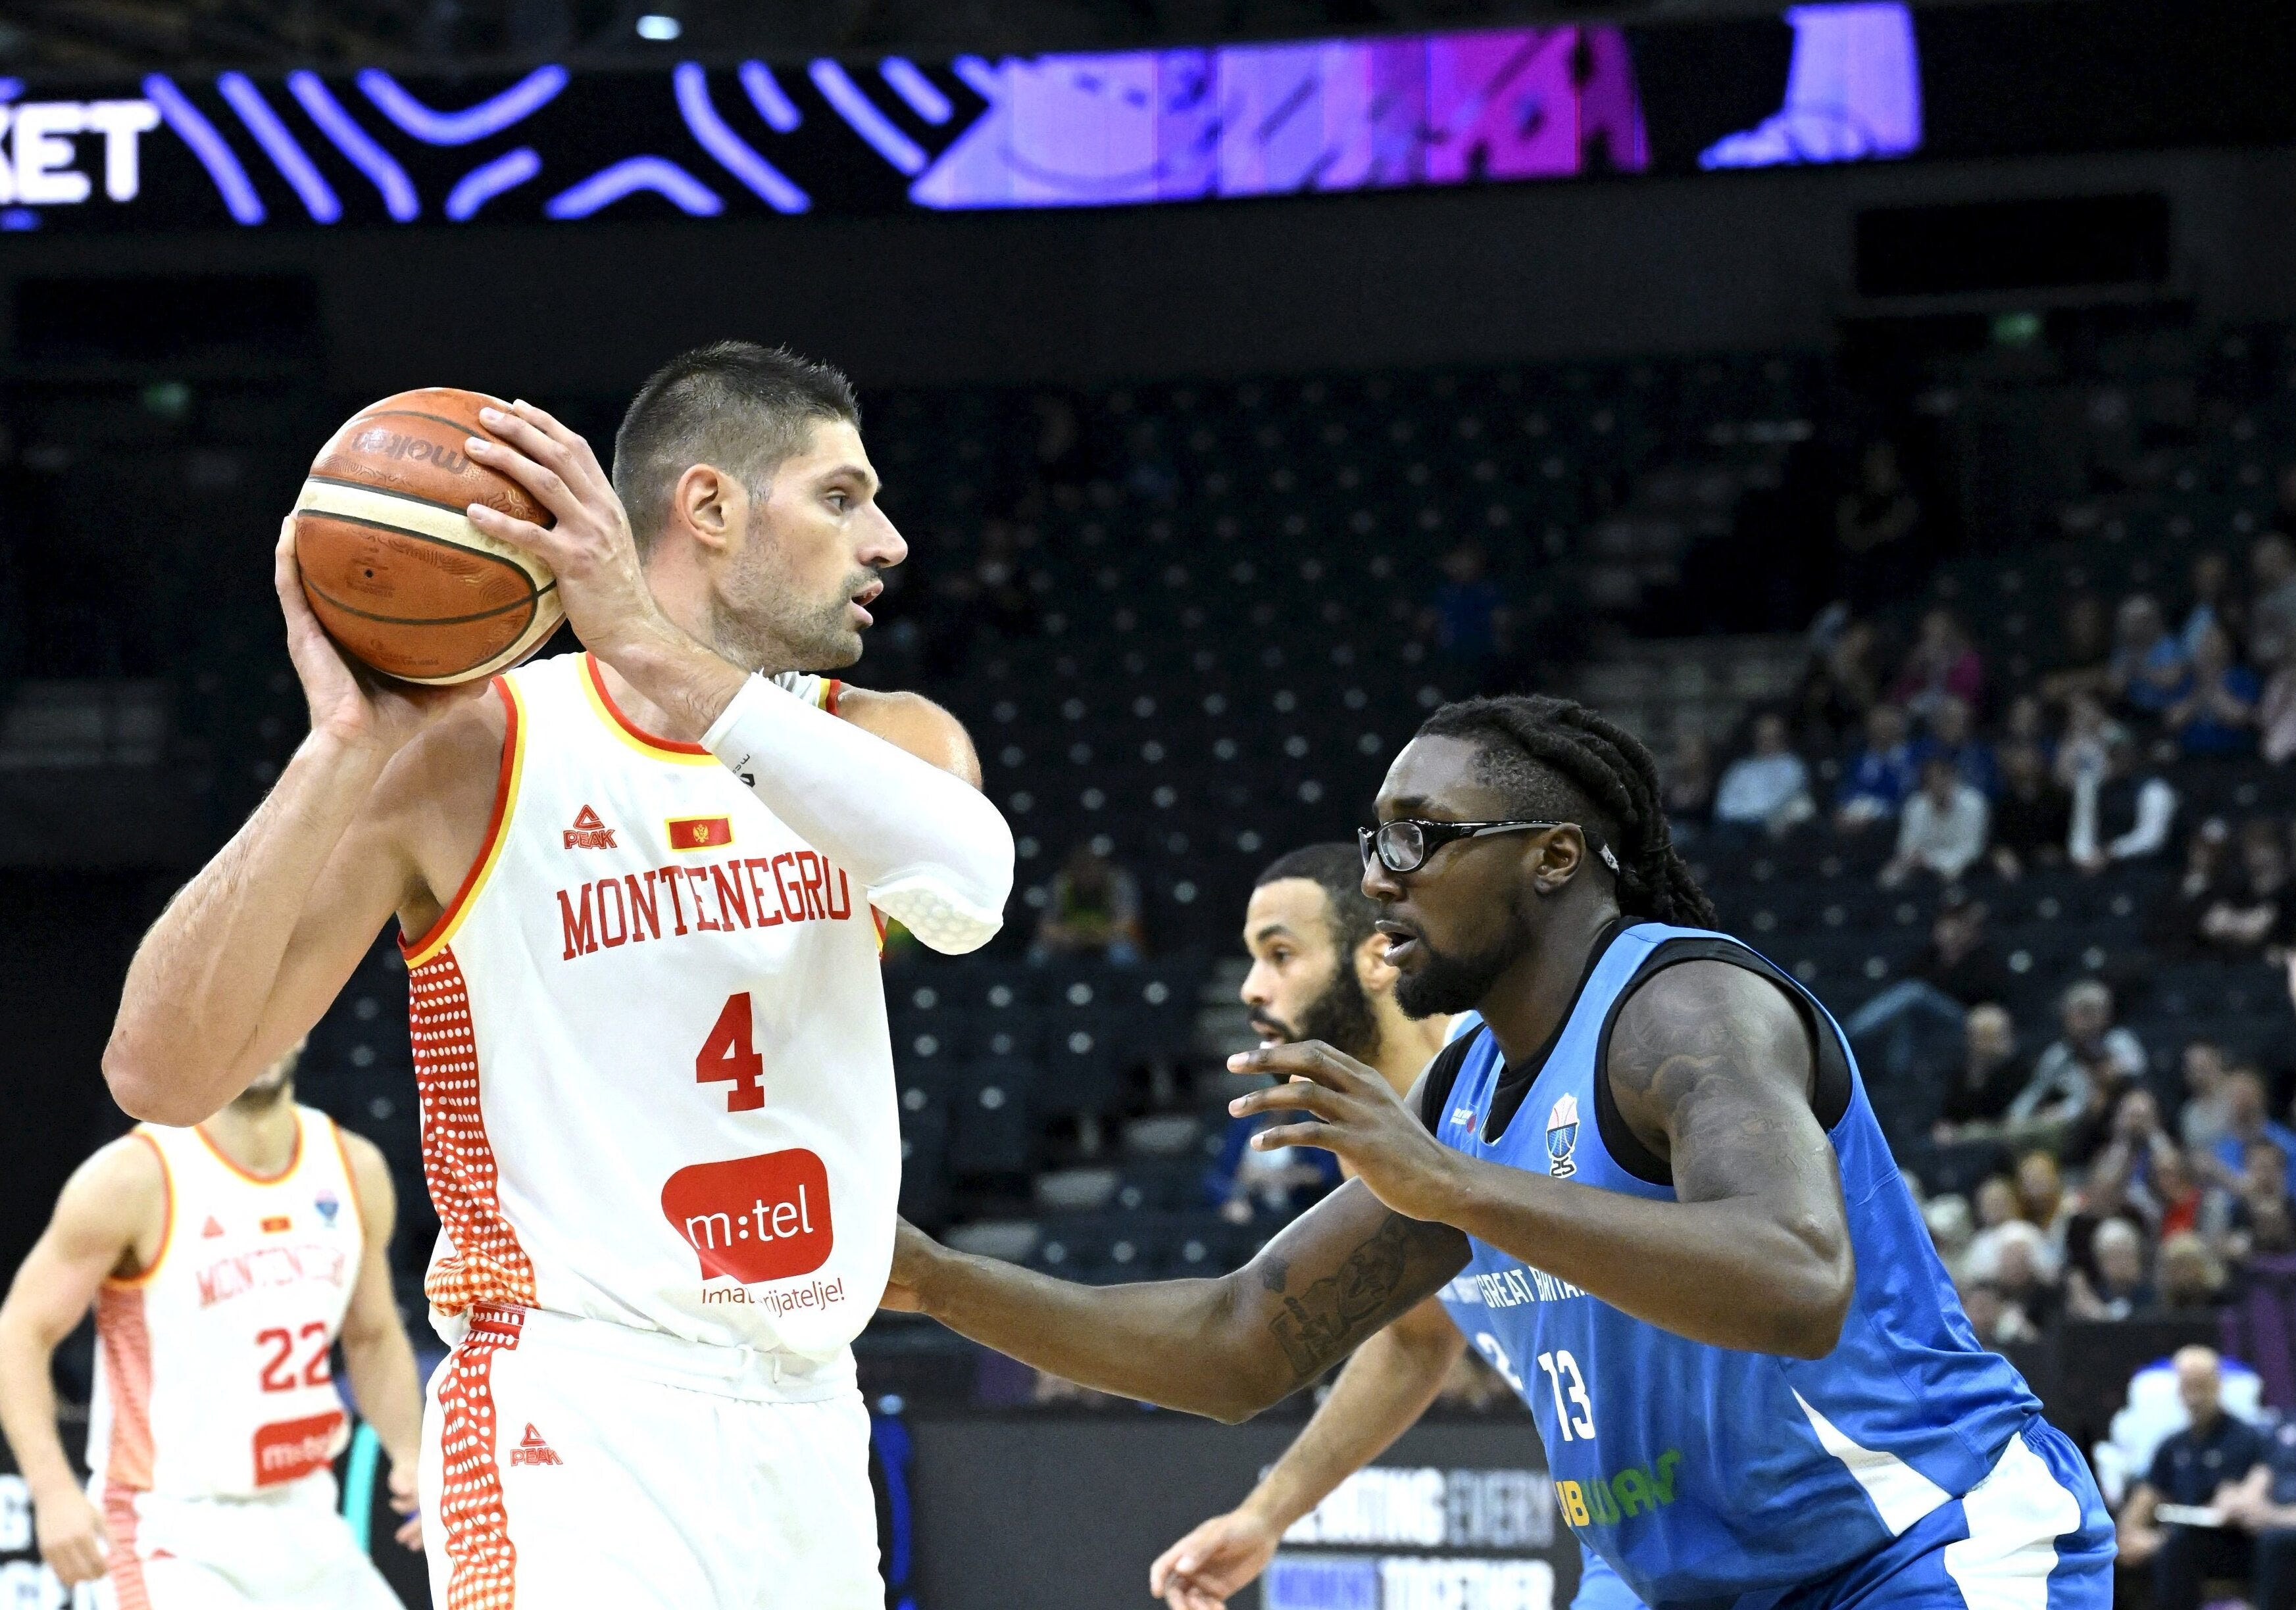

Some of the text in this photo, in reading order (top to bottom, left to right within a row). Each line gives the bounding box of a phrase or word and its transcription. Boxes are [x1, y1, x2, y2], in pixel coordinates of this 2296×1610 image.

[0, 100, 161, 205] ET
[563, 829, 617, 850] PEAK
[557, 850, 851, 961] MONTENEGRO
[696, 992, 765, 1112] 4
[686, 1184, 814, 1250] m:tel
[761, 1277, 845, 1318] rijatelje!
[1476, 1269, 1535, 1308] GREAT
[1528, 1266, 1589, 1302] BRITA
[255, 1320, 331, 1393] 22
[1537, 1350, 1597, 1442] 13
[511, 1448, 563, 1467] PEAK
[1555, 1449, 1681, 1526] UBWAY
